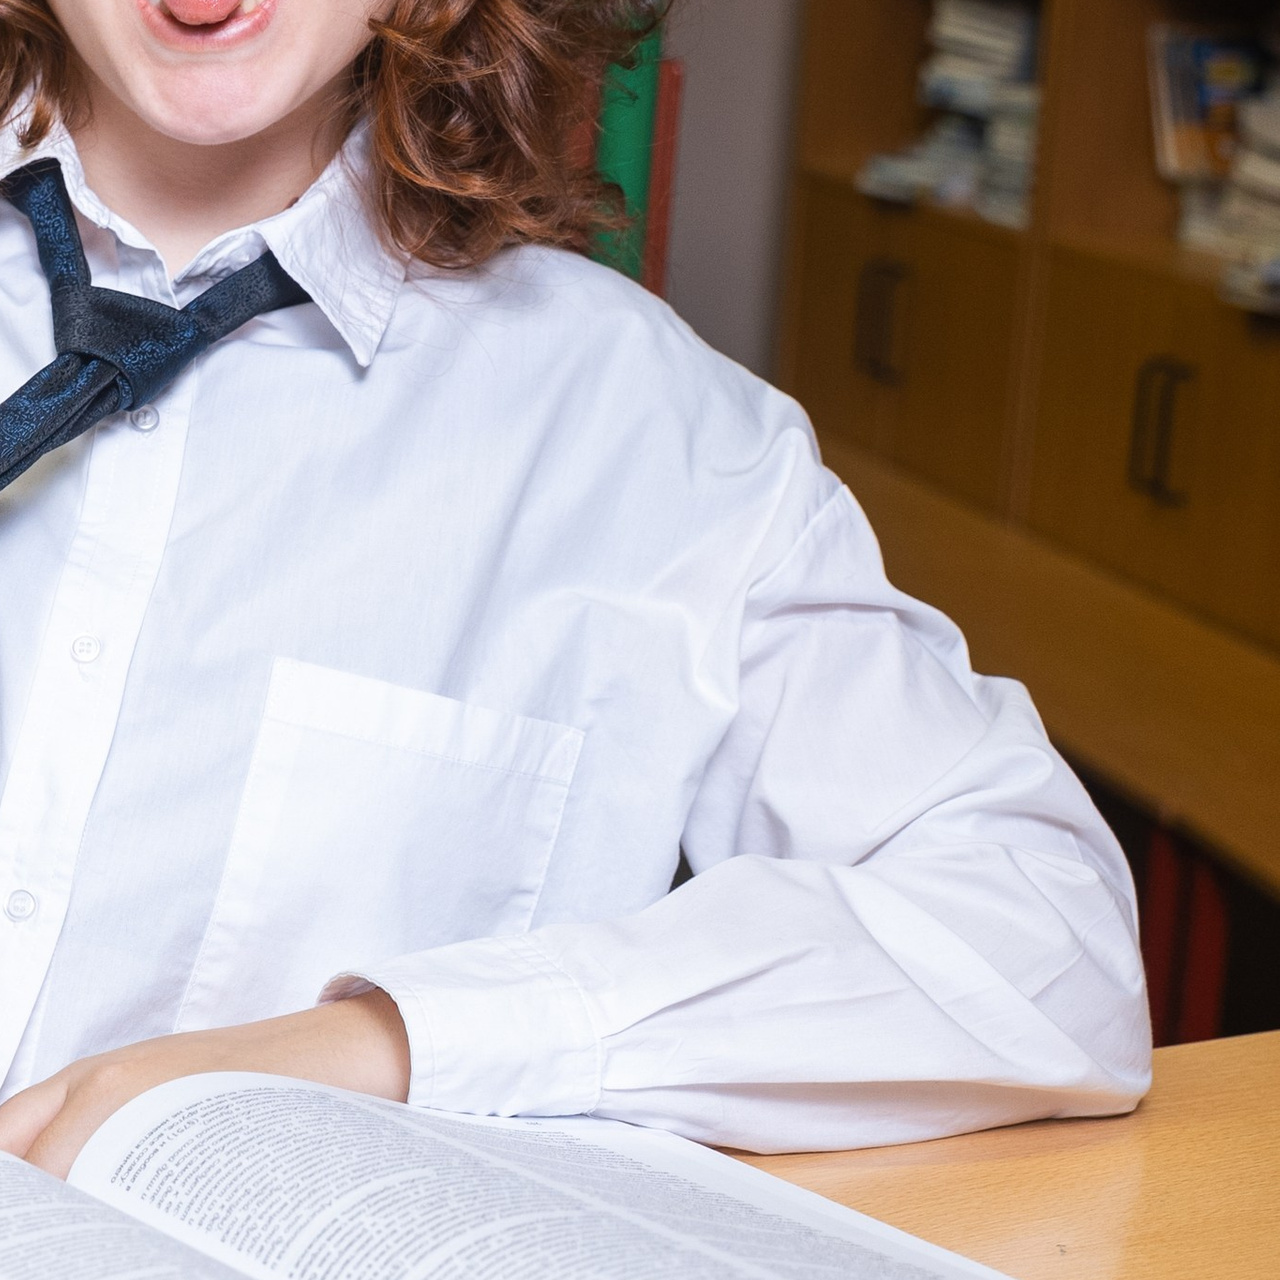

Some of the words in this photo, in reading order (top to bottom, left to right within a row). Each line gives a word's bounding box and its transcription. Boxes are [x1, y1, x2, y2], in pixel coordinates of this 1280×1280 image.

[134, 1118, 170, 1149] имеется
[163, 1109, 198, 1131] другое,
[166, 1118, 199, 1141] (§751)
[211, 1124, 250, 1146] Однако
[149, 1132, 164, 1146] все
[167, 1138, 195, 1163] силой
[110, 1150, 134, 1184] ничего
[119, 1147, 149, 1186] согласу-
[130, 1147, 159, 1183] вообще
[171, 1156, 198, 1184] самом
[181, 1135, 240, 1188] воображение
[222, 1144, 255, 1169] случае
[145, 1163, 168, 1191] души
[150, 1169, 174, 1202] деяте-
[184, 1158, 221, 1196] следует
[194, 1161, 243, 1214] возникают
[217, 1153, 271, 1198] возникают
[225, 1163, 269, 1202] относят
[157, 1185, 173, 1209] деле
[173, 1201, 183, 1216] ис-
[182, 1168, 222, 1218] возникает
